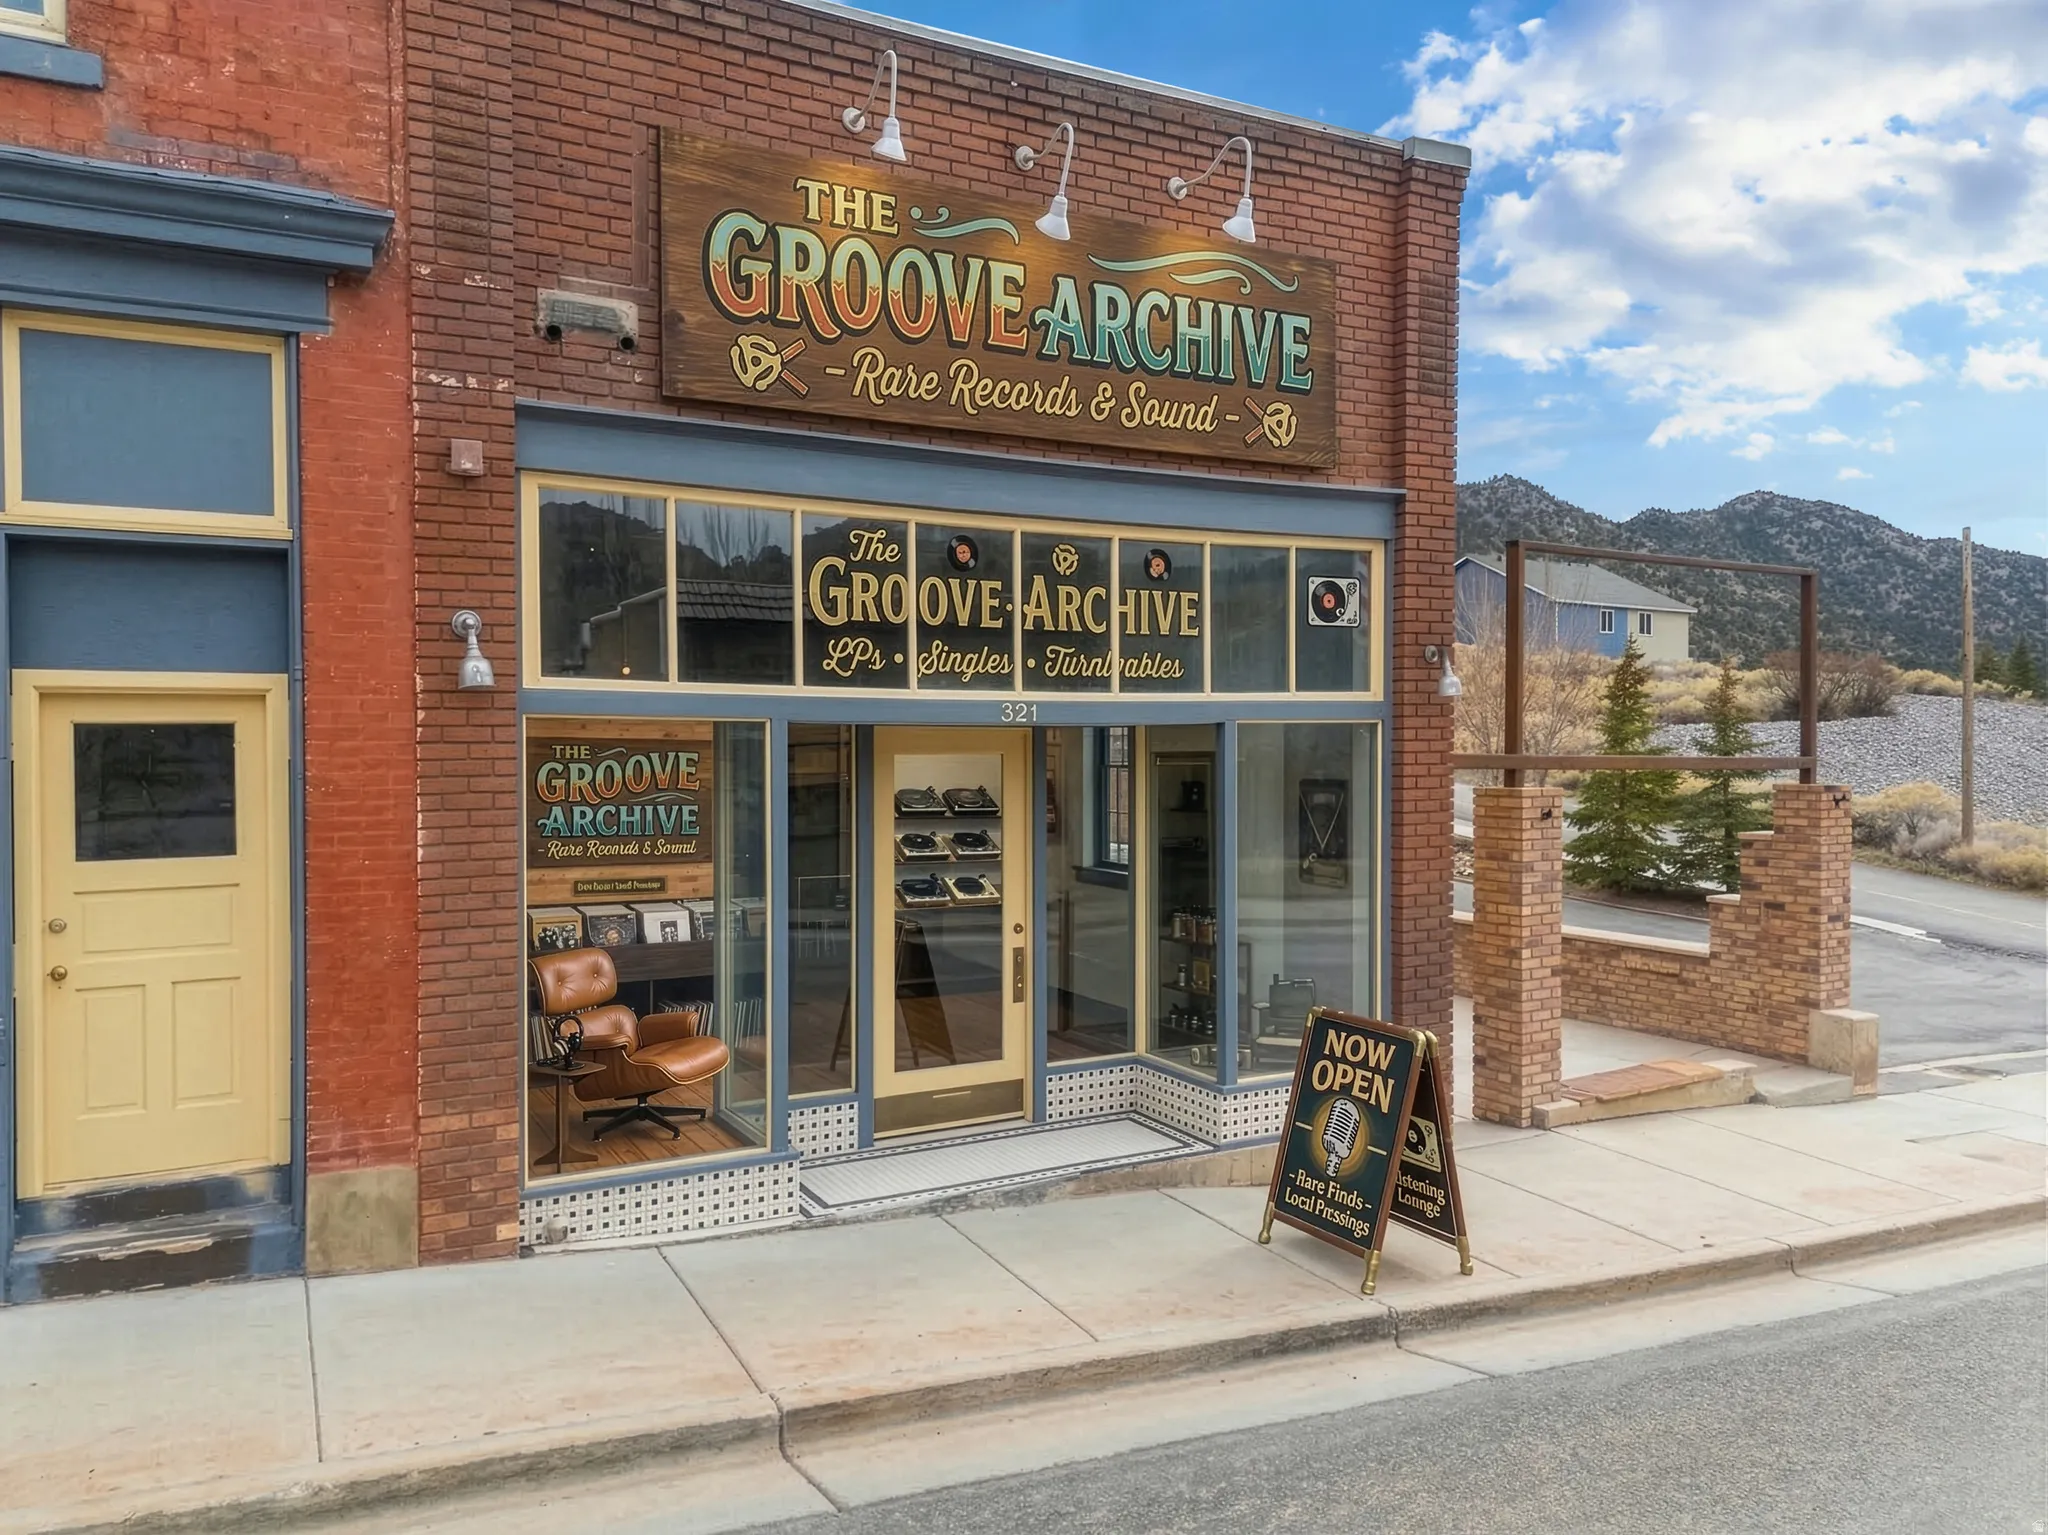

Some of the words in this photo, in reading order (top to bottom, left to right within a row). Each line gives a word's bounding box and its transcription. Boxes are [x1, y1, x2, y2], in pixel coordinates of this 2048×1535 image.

[796, 178, 898, 235] THE
[708, 211, 1028, 350] GROOVE
[1034, 275, 1314, 387] ARCHIVE
[852, 347, 942, 404] Rare
[949, 358, 1082, 415] Records
[1090, 382, 1116, 421] &
[1120, 381, 1219, 432] Sound
[850, 529, 901, 562] The
[1023, 575, 1199, 636] ARCHIVE
[823, 636, 886, 678] LPs
[917, 639, 1013, 682] Singles
[1001, 702, 1037, 722] 321
[552, 745, 591, 759] THE
[536, 752, 701, 804] GROOVE
[537, 804, 700, 837] ARCHIVE
[1323, 1028, 1397, 1071] NOW
[1312, 1059, 1395, 1114] OPEN
[1326, 1180, 1364, 1210] Finds
